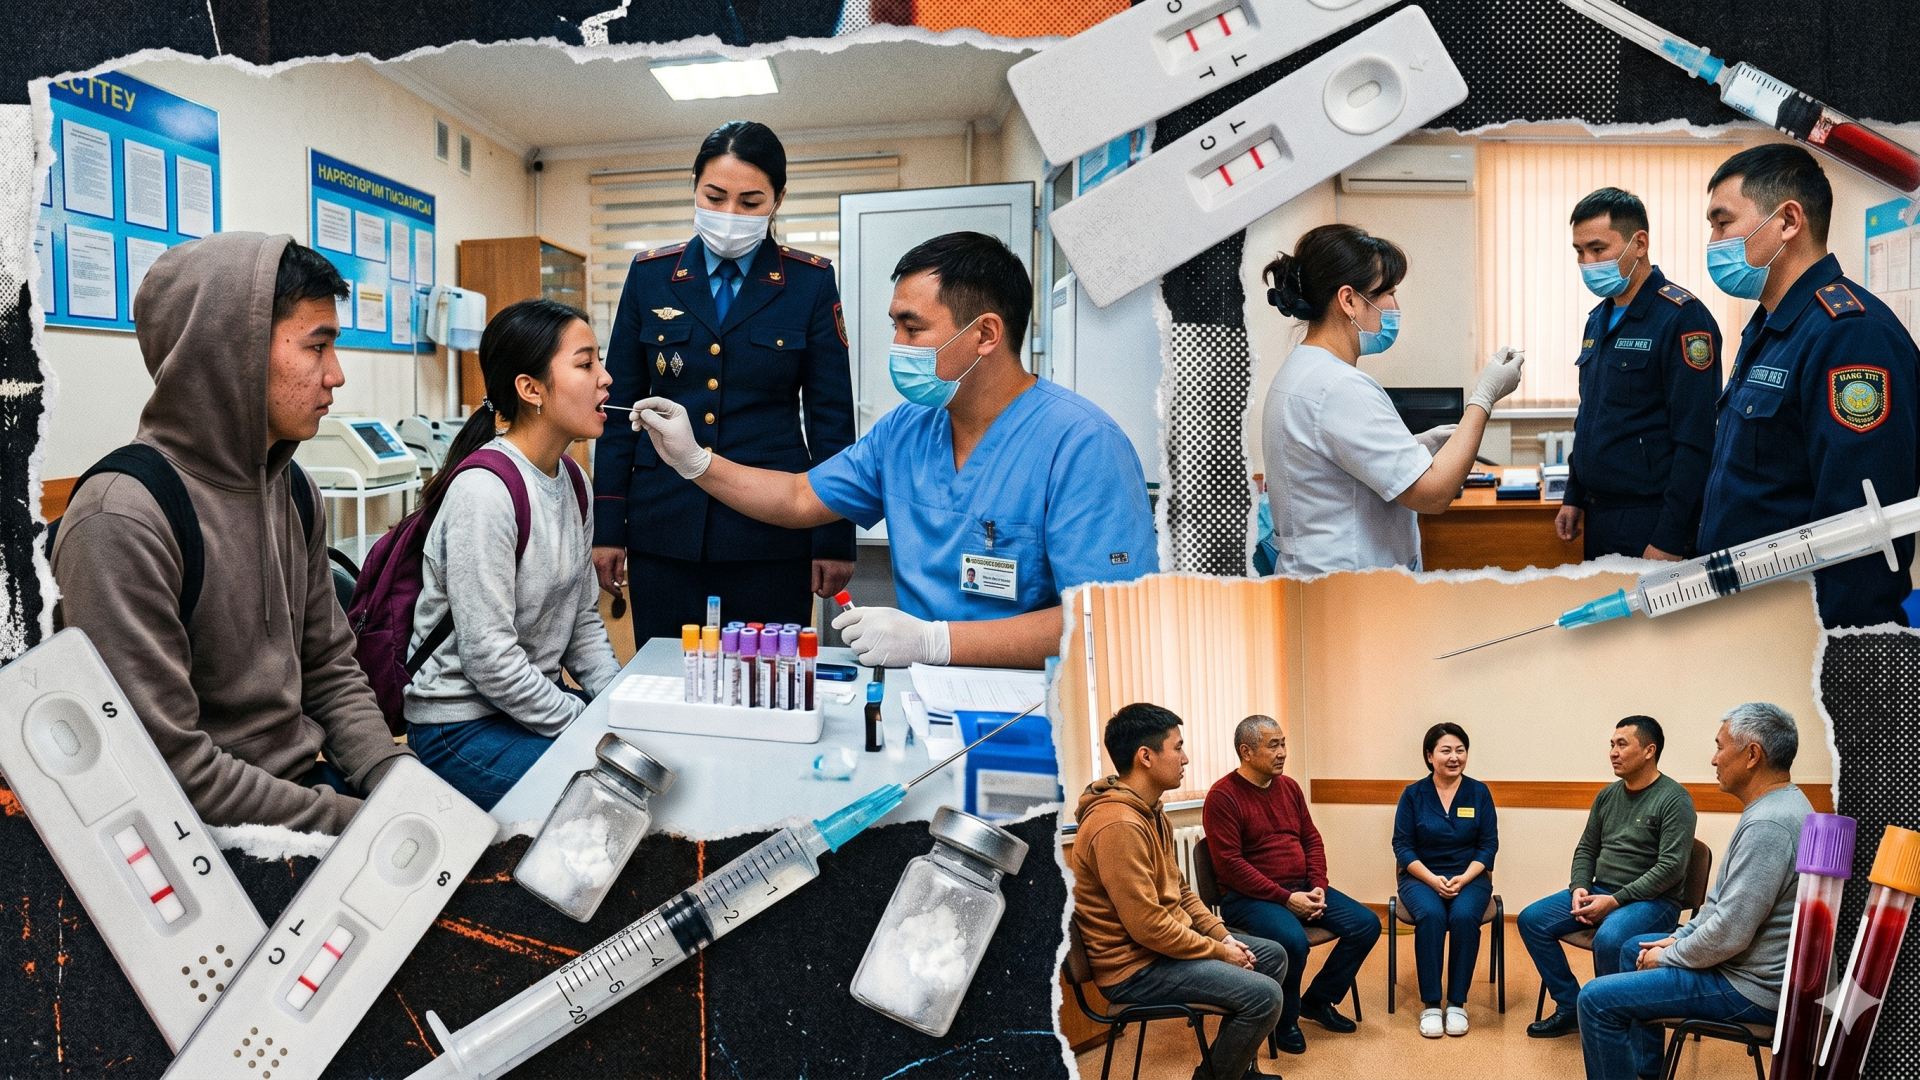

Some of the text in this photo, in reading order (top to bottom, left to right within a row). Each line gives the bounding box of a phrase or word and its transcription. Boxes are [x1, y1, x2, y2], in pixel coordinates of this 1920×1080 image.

[55, 77, 136, 112] СТТЕУ
[1200, 120, 1246, 150] C T
[102, 701, 118, 718] S
[174, 821, 211, 876] C T
[766, 886, 779, 897] 1
[724, 909, 740, 924] 2
[268, 919, 305, 965] C T
[651, 956, 665, 968] 4
[609, 980, 625, 994] 5
[568, 1005, 588, 1026] 20
